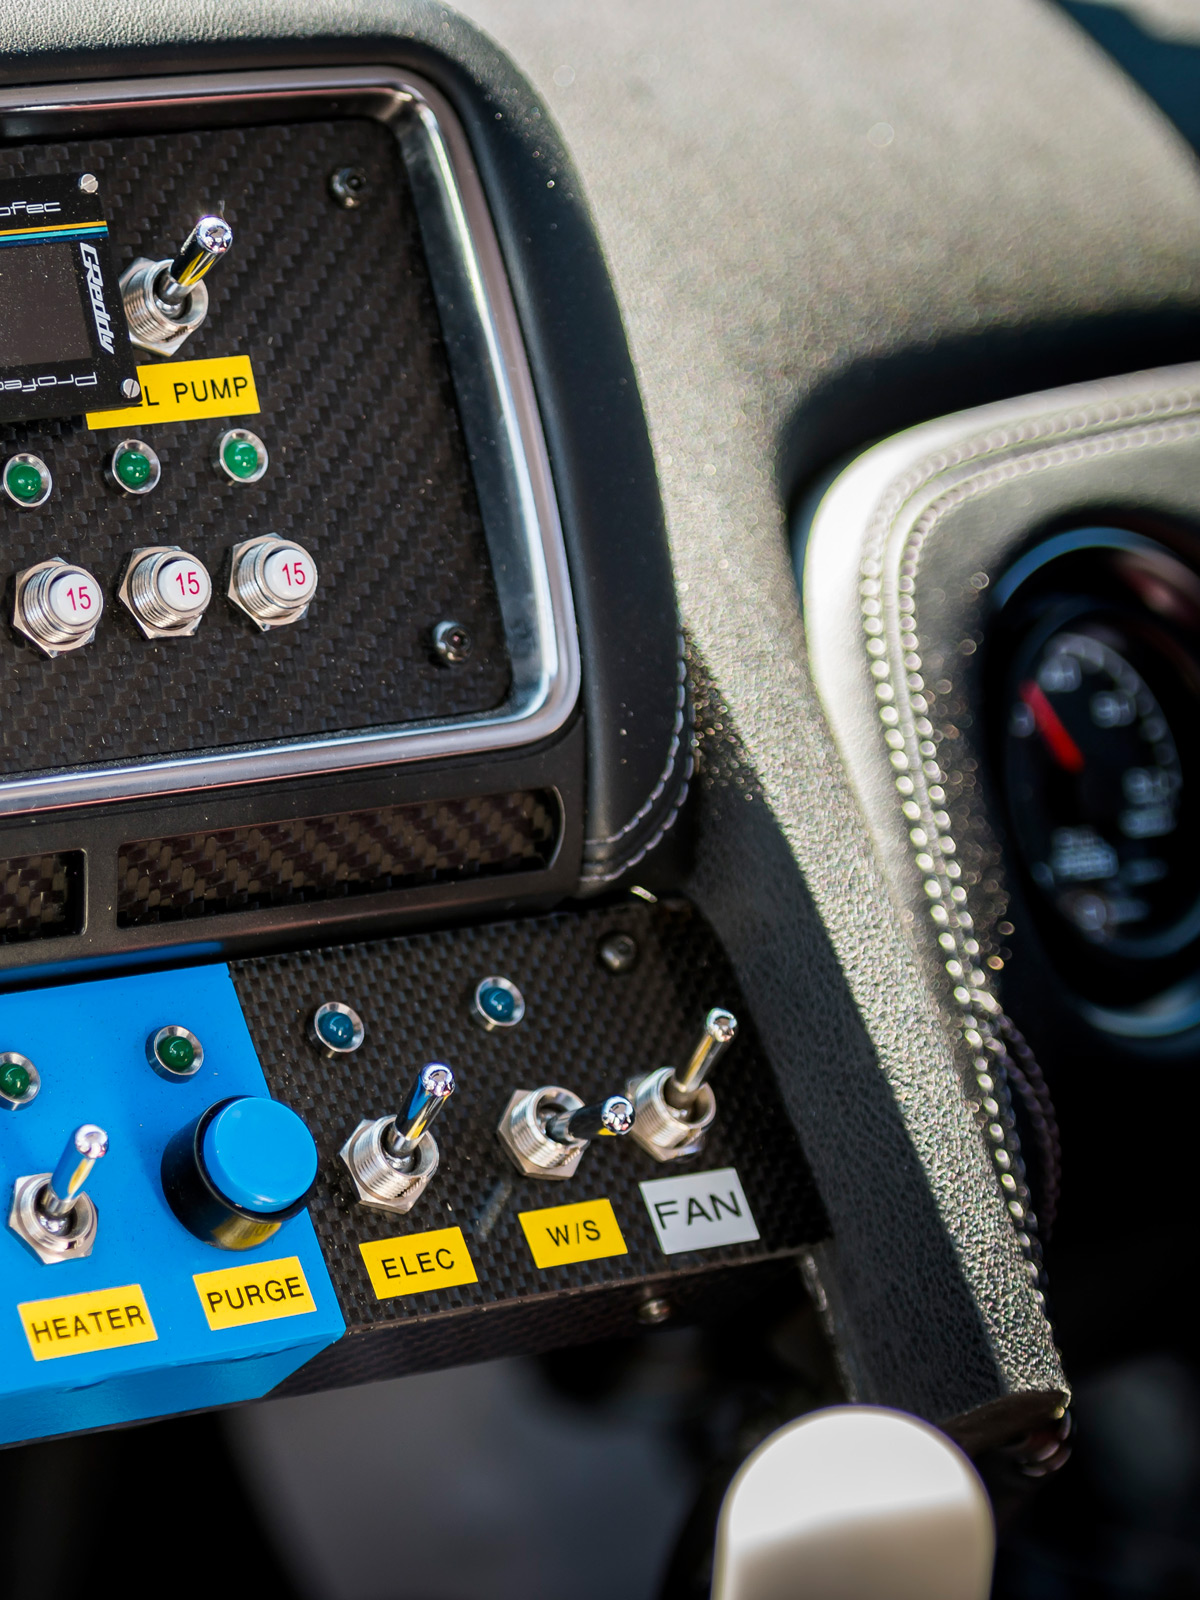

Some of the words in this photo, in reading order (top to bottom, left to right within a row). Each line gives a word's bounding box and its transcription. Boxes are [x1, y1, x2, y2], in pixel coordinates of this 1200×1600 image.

[173, 376, 248, 404] PUMP
[174, 571, 202, 598] 15
[280, 561, 307, 588] 15
[65, 586, 93, 612] 15
[654, 1191, 744, 1231] FAN
[546, 1220, 602, 1247] W/S
[381, 1249, 456, 1280] ELEC
[206, 1276, 305, 1314] PURGE
[31, 1305, 146, 1344] HEATER
